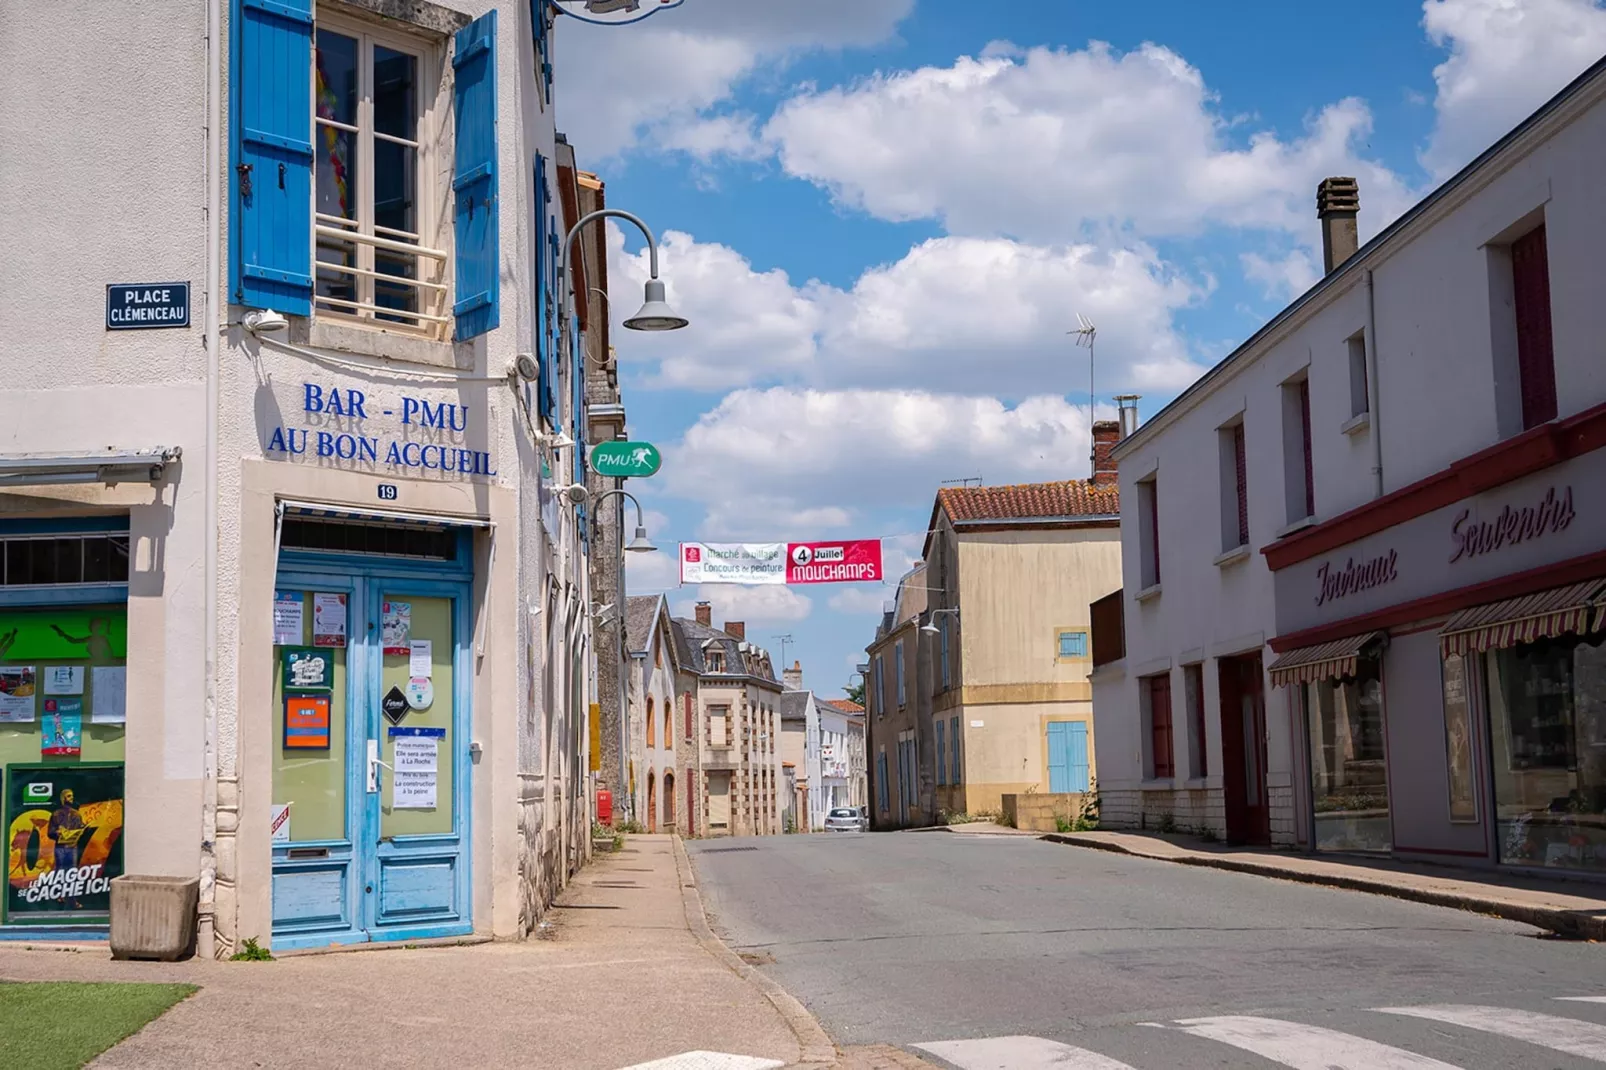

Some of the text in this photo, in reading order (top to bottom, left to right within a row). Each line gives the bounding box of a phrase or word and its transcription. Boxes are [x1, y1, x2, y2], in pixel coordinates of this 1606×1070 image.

[125, 289, 171, 304] PLACE
[111, 306, 184, 322] CLÉMENCEAU
[303, 383, 368, 419] BAR
[401, 396, 469, 432] PMU
[267, 426, 498, 476] AU BON ACCUEIL
[596, 453, 631, 466] PMU
[379, 485, 396, 499] 19
[1448, 485, 1577, 564] Souvenirs
[707, 547, 740, 559] Marché
[751, 548, 779, 561] village
[797, 549, 843, 562] 4 Juillet
[703, 562, 740, 573] Concours
[750, 562, 783, 574] peinture
[792, 562, 876, 581] MOUCHAMPS
[1314, 547, 1398, 607] Journaux
[29, 864, 102, 889] LE MAGOT
[17, 876, 111, 903] SE CACHE ICI.
